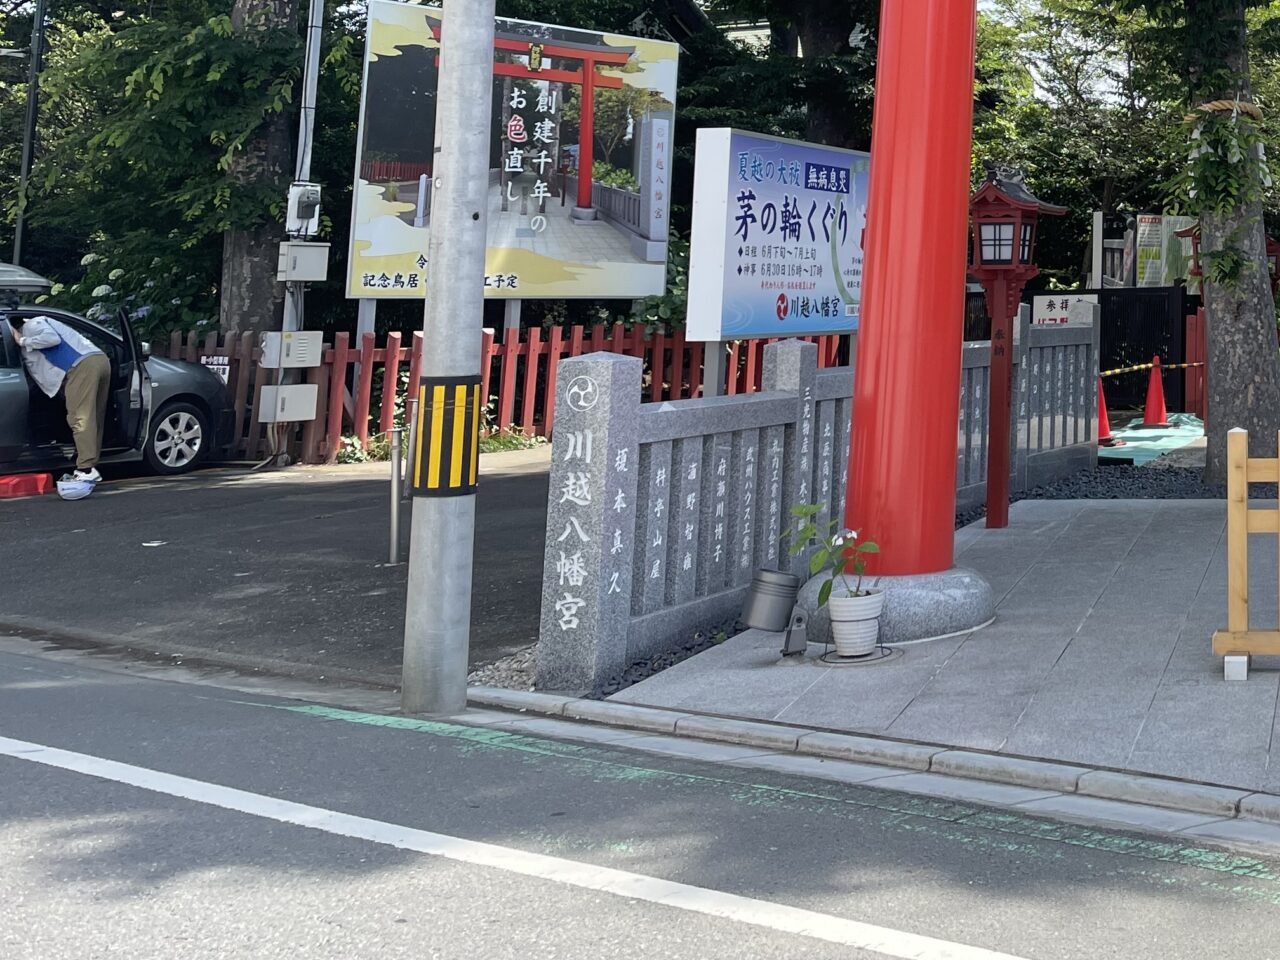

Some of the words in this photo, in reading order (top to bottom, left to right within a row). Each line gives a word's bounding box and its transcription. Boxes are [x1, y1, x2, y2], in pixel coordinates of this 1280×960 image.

[504, 87, 527, 201] お色直し
[530, 91, 557, 232] 創建千年の
[738, 152, 800, 186] 夏越の大祓
[735, 189, 848, 246] 茅の輪くぐり
[790, 294, 840, 318] 川越八幡宮
[555, 431, 593, 631] 川越八幡宮
